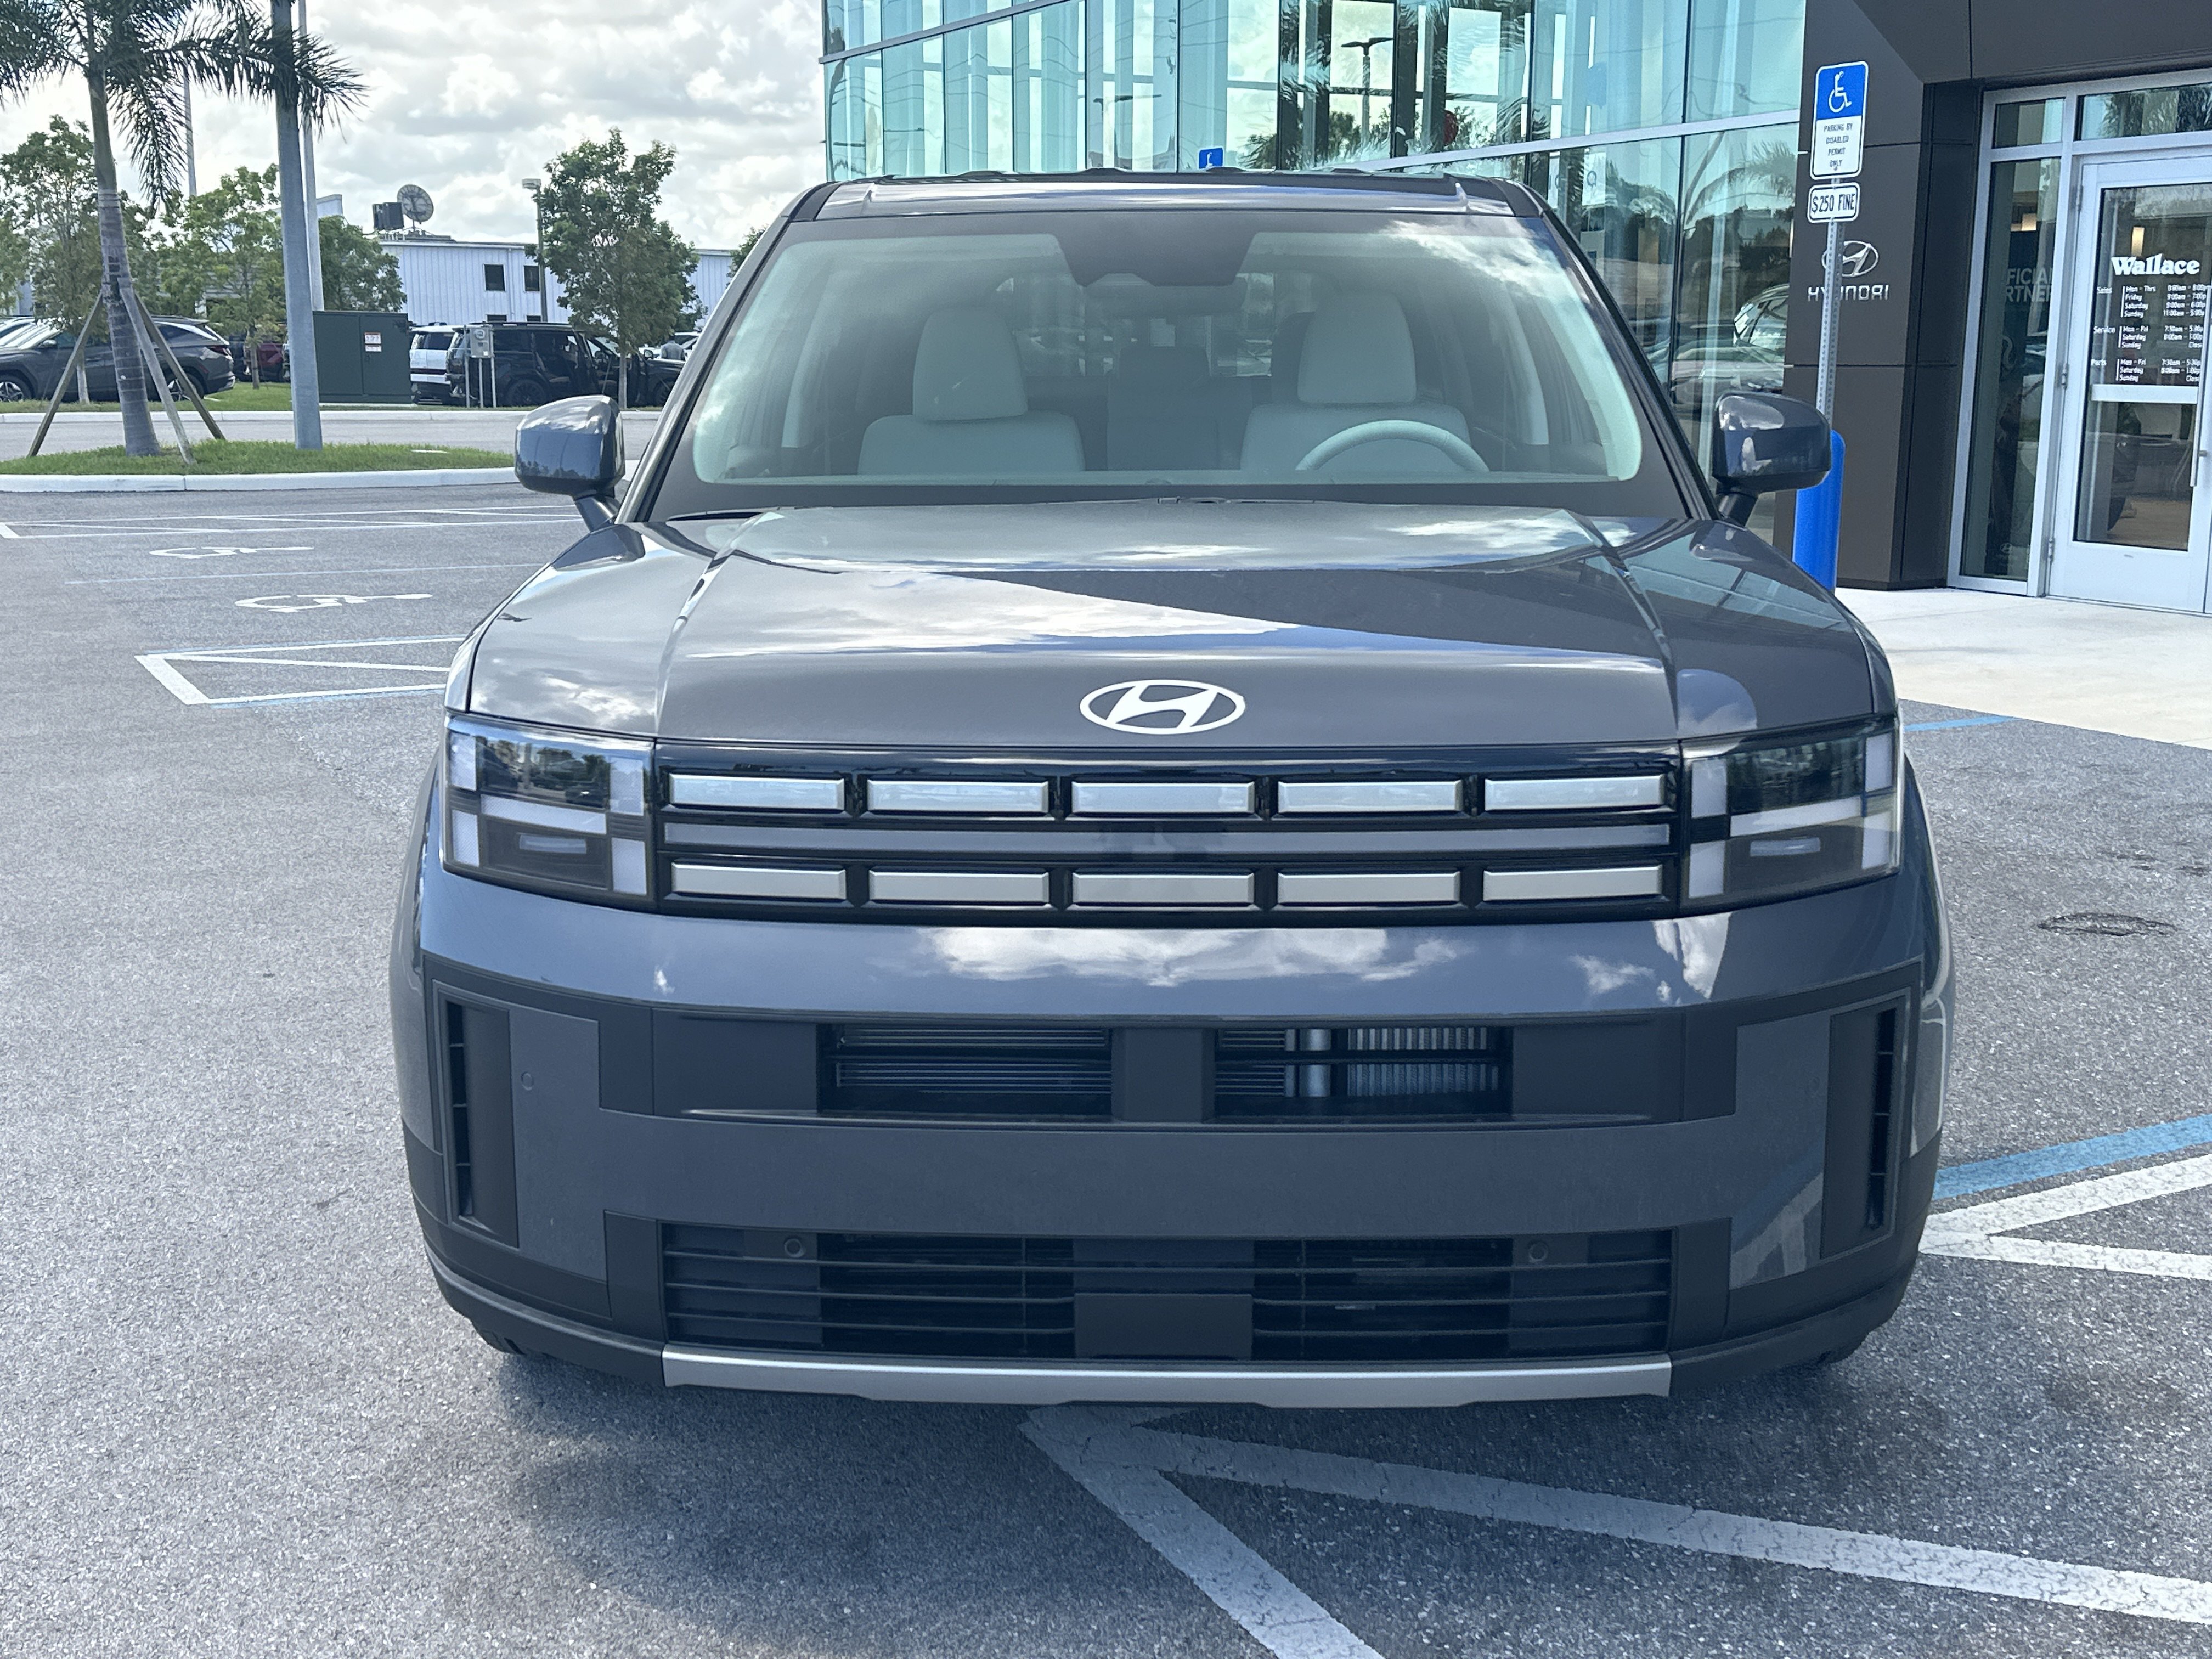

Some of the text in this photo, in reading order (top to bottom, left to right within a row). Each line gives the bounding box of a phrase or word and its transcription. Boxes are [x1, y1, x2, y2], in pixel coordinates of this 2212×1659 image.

[1824, 123, 1844, 132] PARKING
[1827, 147, 1846, 156] PERMIT
[1812, 193, 1855, 213] $250 FINE
[2111, 253, 2200, 275] Wallace
